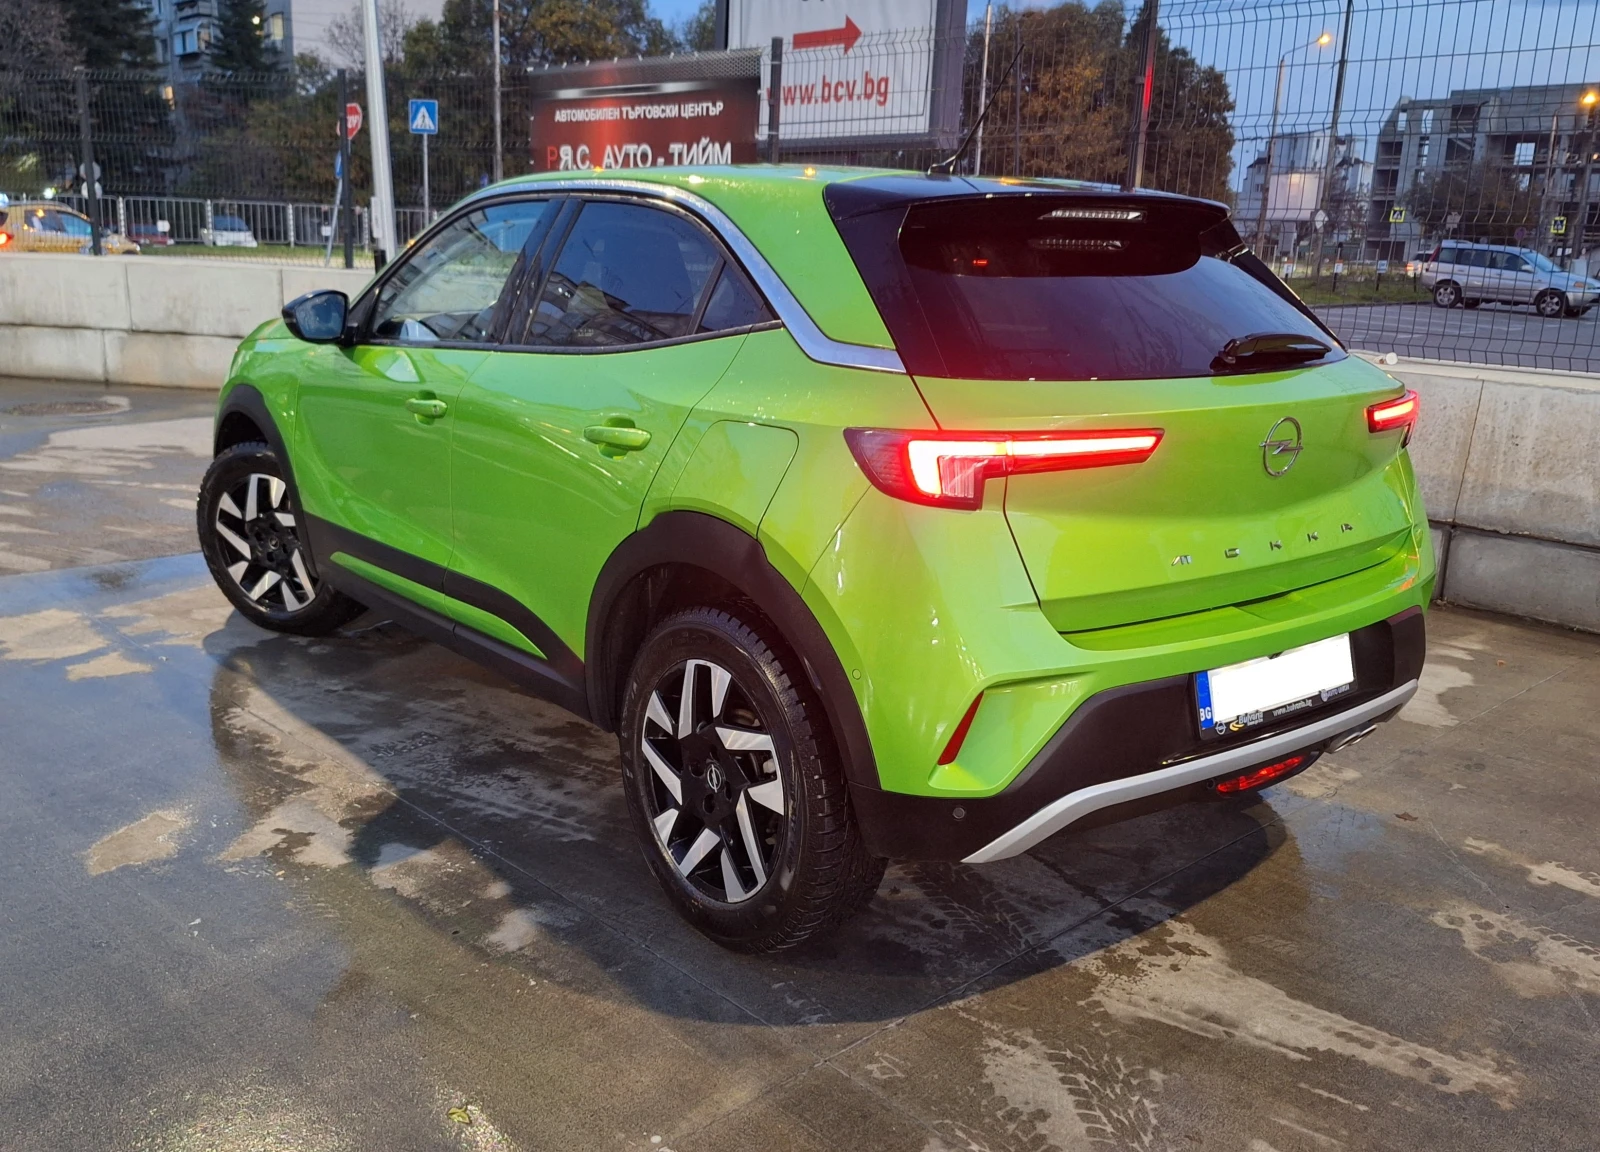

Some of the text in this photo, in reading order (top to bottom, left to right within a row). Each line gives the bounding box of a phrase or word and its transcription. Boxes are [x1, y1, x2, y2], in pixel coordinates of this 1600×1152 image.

[555, 102, 724, 122] АВТОМОБИЛЕН ТЪРГОВСКИ ЦЕНТЪР
[602, 143, 652, 169] АУТО
[669, 136, 732, 166] ТИЙМ
[1171, 523, 1353, 566] MOKKA
[1199, 706, 1212, 722] BG
